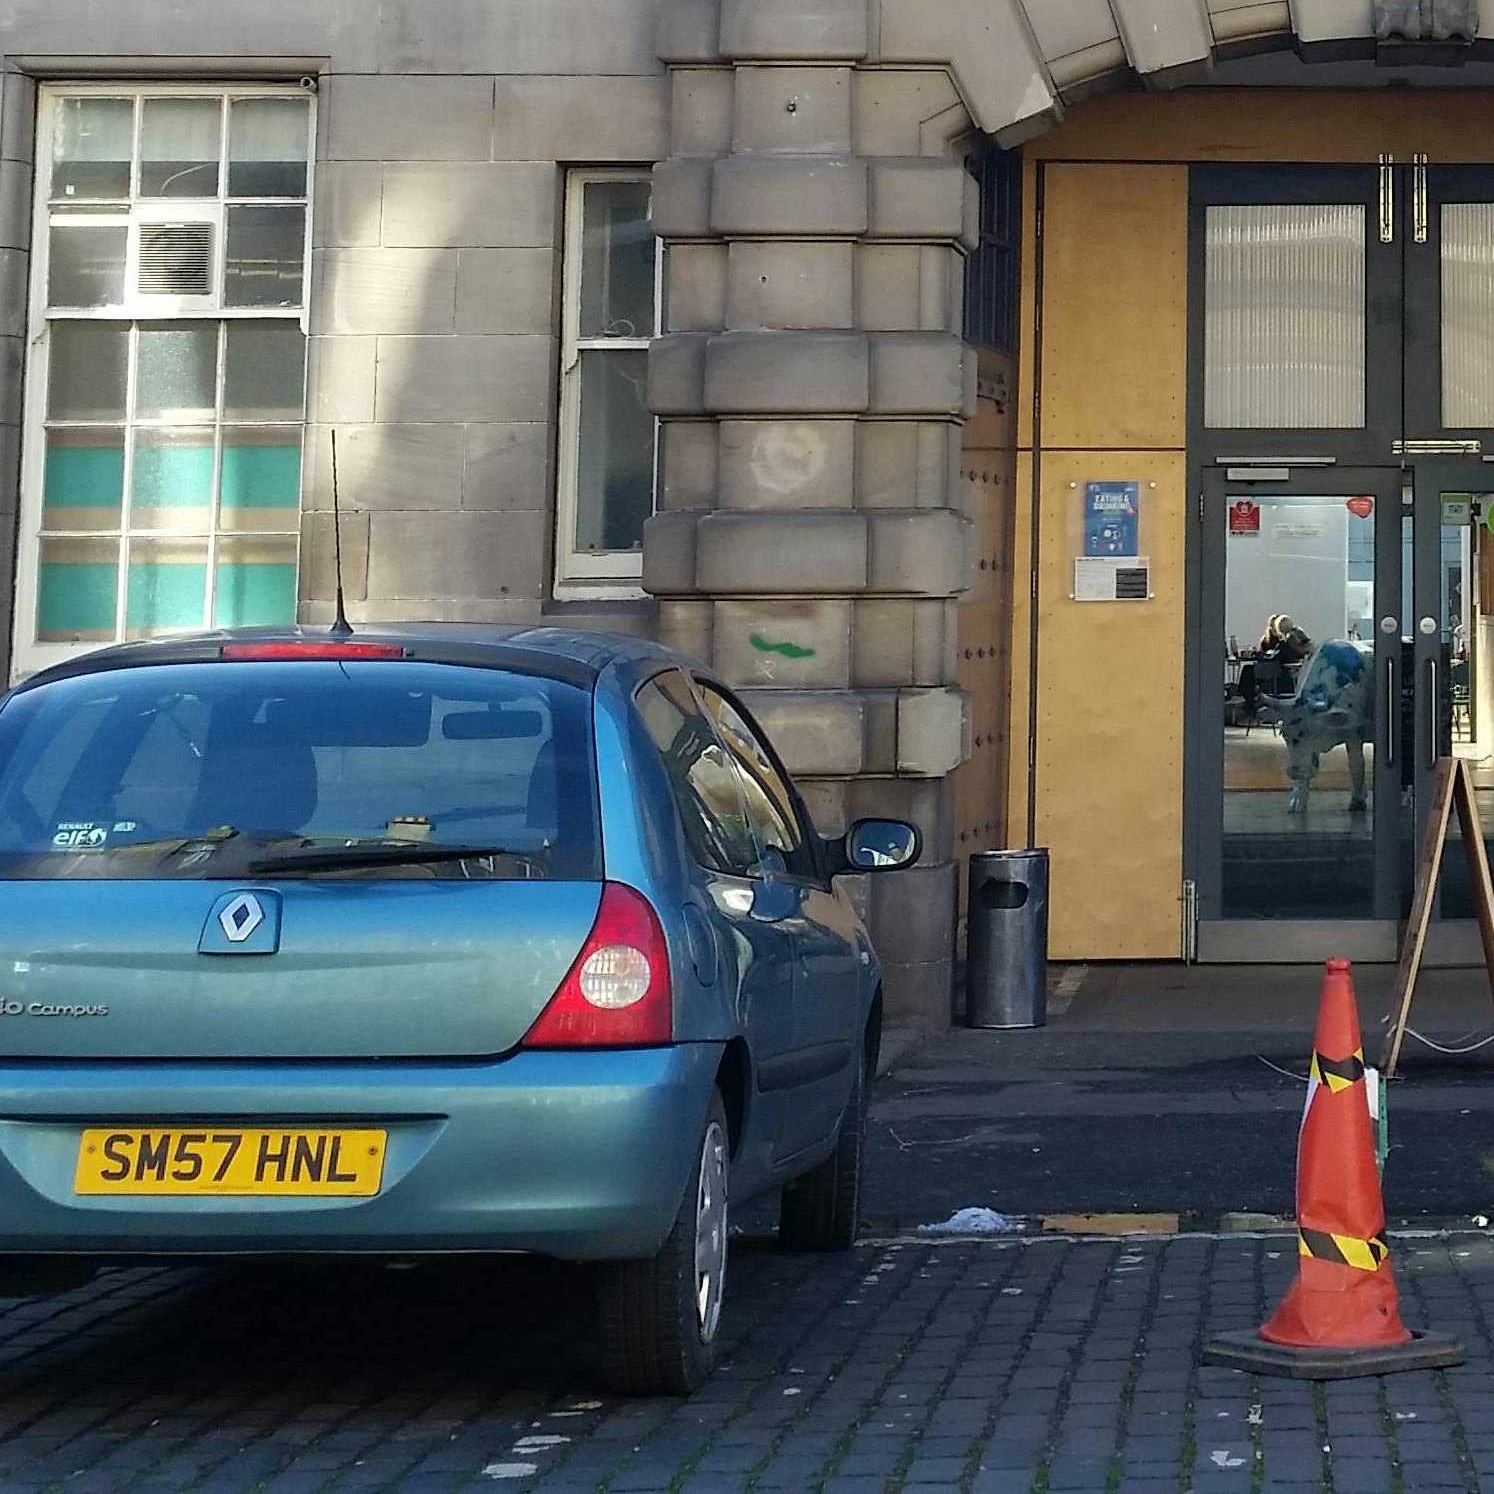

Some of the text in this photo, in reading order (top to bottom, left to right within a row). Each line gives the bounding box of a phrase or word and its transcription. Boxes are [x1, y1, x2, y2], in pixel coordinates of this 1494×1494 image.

[27, 1002, 109, 1017] Campus
[100, 1134, 357, 1182] SM57 HNL
